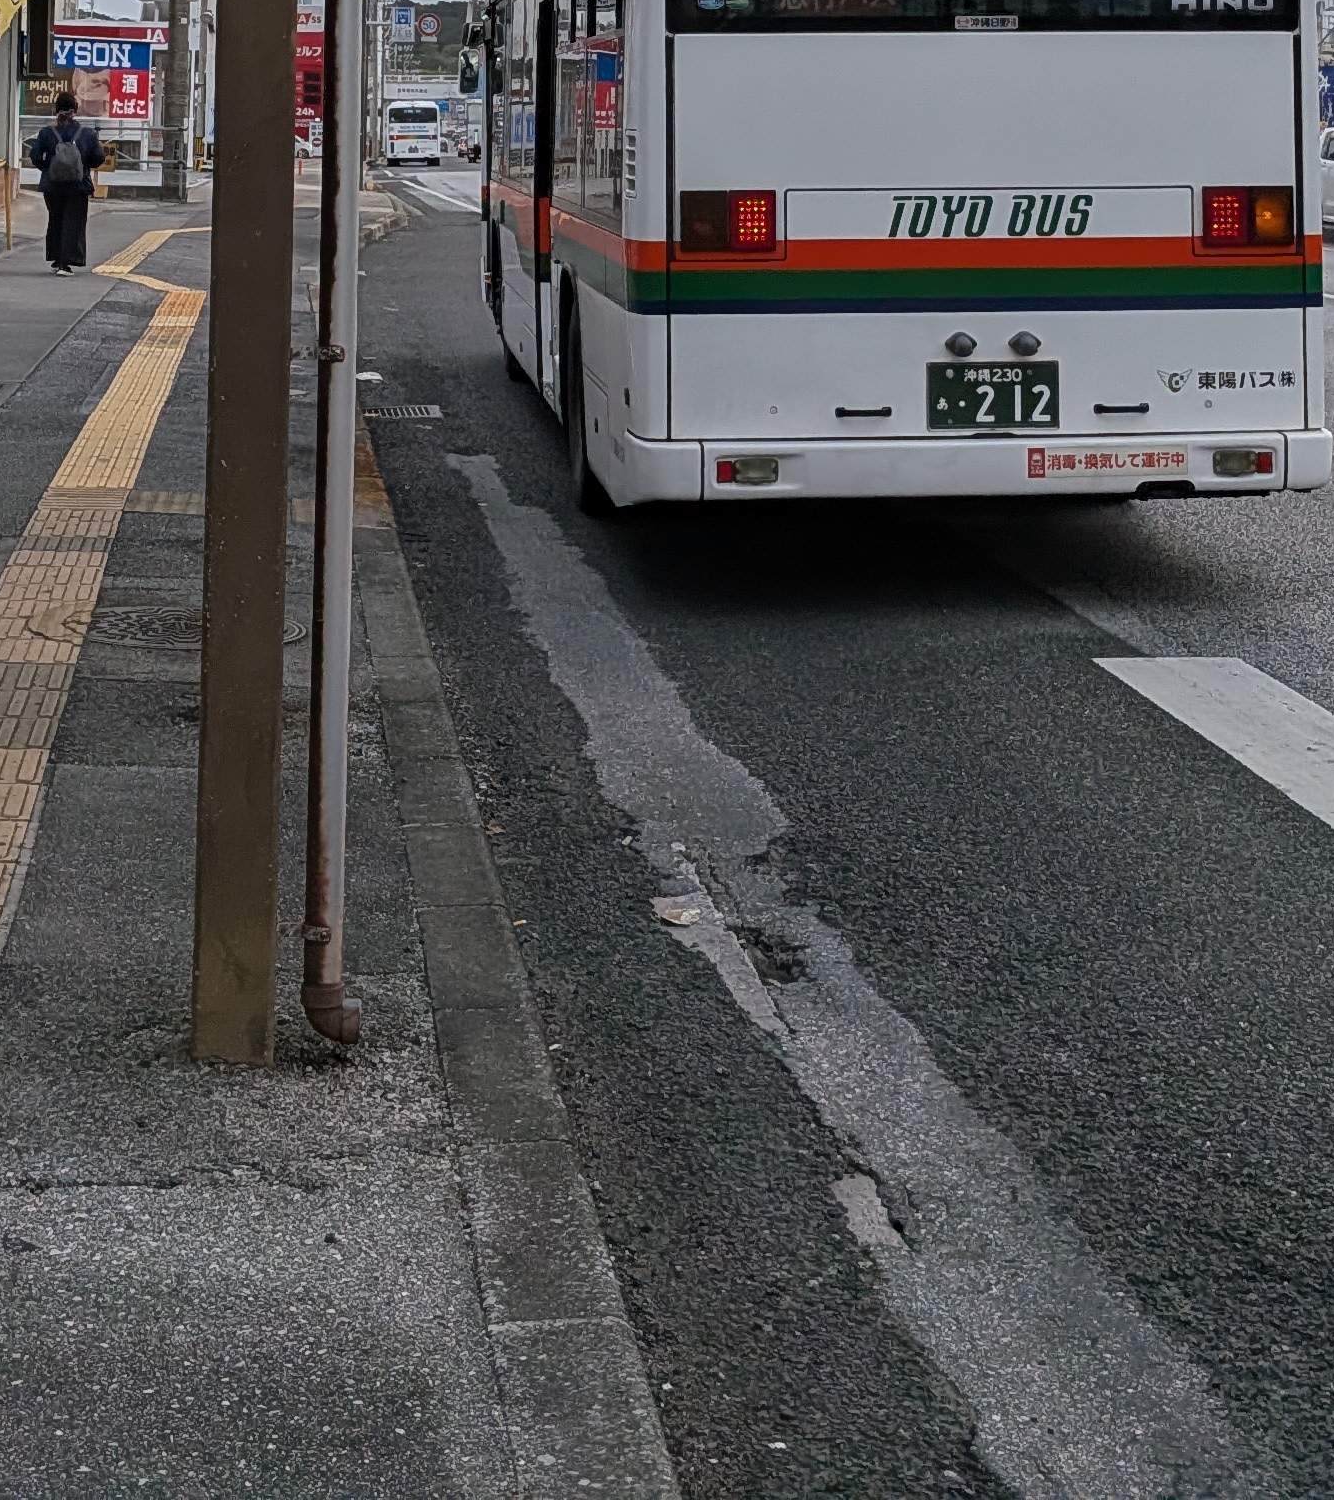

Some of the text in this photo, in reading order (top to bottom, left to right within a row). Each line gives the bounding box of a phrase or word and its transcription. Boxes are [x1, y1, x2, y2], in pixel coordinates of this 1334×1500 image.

[422, 19, 436, 30] 50
[29, 80, 68, 92] MACHI
[122, 74, 139, 95] 酒
[111, 98, 147, 115] たばこ
[295, 107, 315, 116] 24h
[888, 195, 1094, 238] TOYO BUS
[1046, 451, 1185, 471] 消毒・換気して運行中
